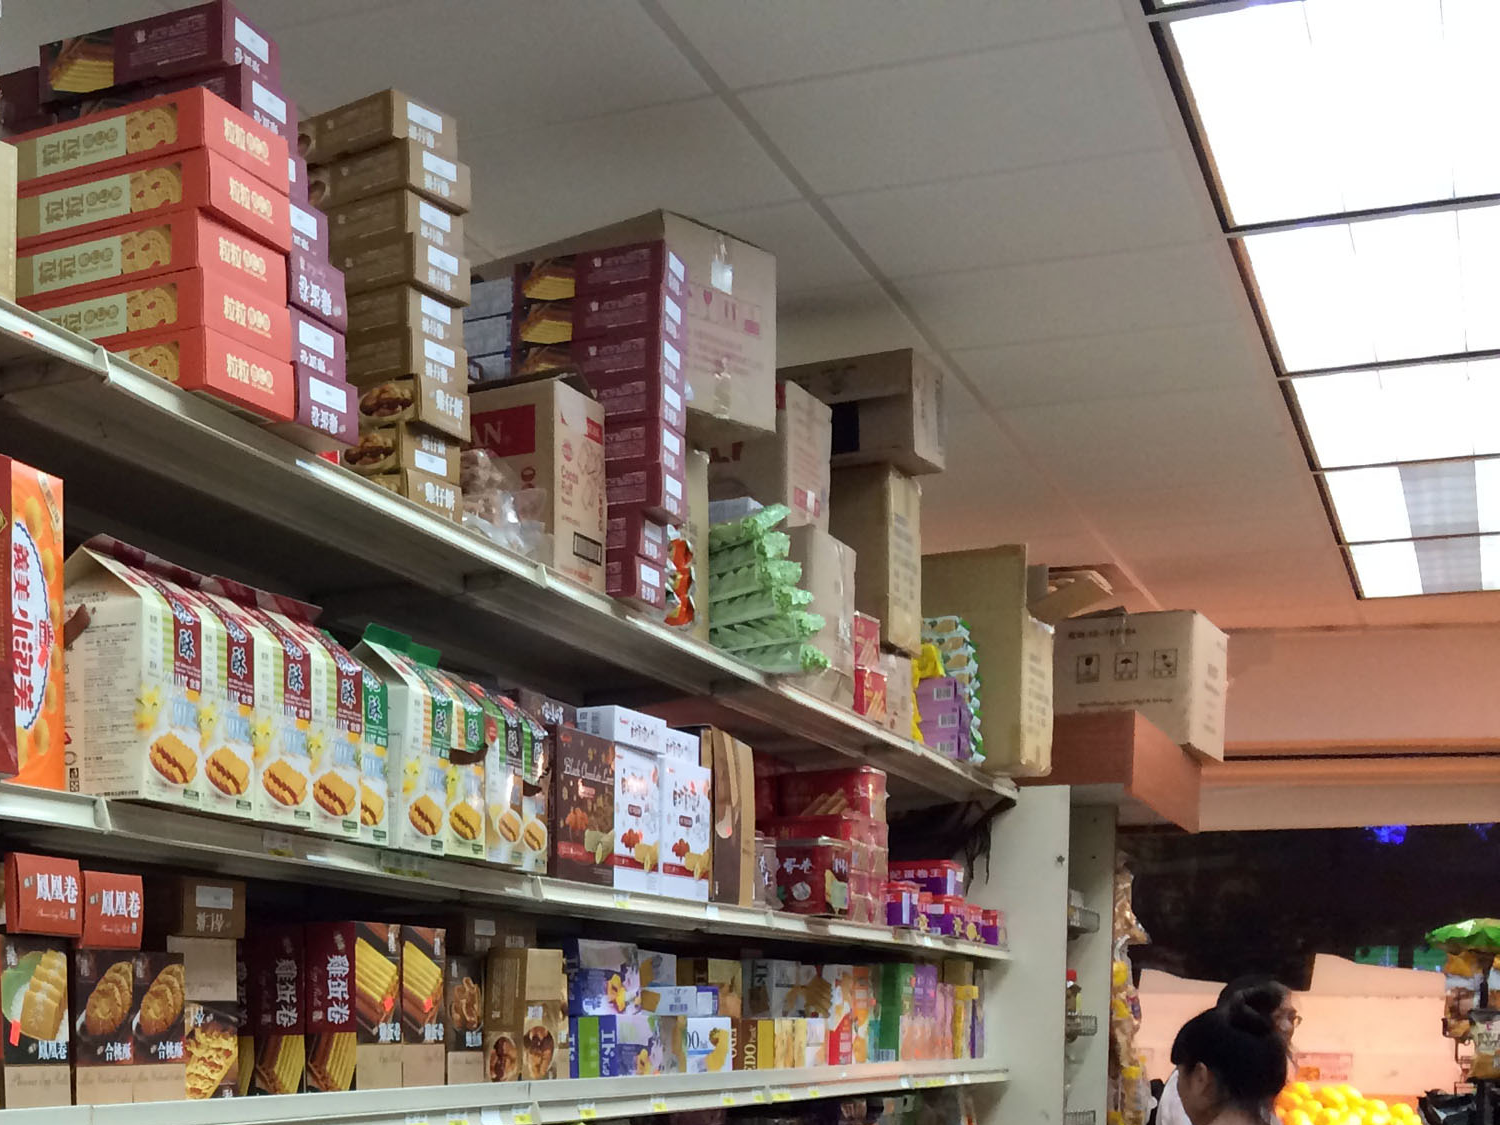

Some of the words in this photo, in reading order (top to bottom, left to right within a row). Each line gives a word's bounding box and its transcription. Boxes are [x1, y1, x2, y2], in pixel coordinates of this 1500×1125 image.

[36, 873, 78, 904] 鳳凰卷
[101, 889, 141, 919] 鳳凰卷
[275, 957, 298, 1028] 雞蛋卷
[326, 955, 350, 1025] 雞蛋卷
[37, 1041, 67, 1060] 鳳凰卷
[104, 1041, 131, 1061] 合桃酥
[157, 1041, 183, 1061] 合桃酥
